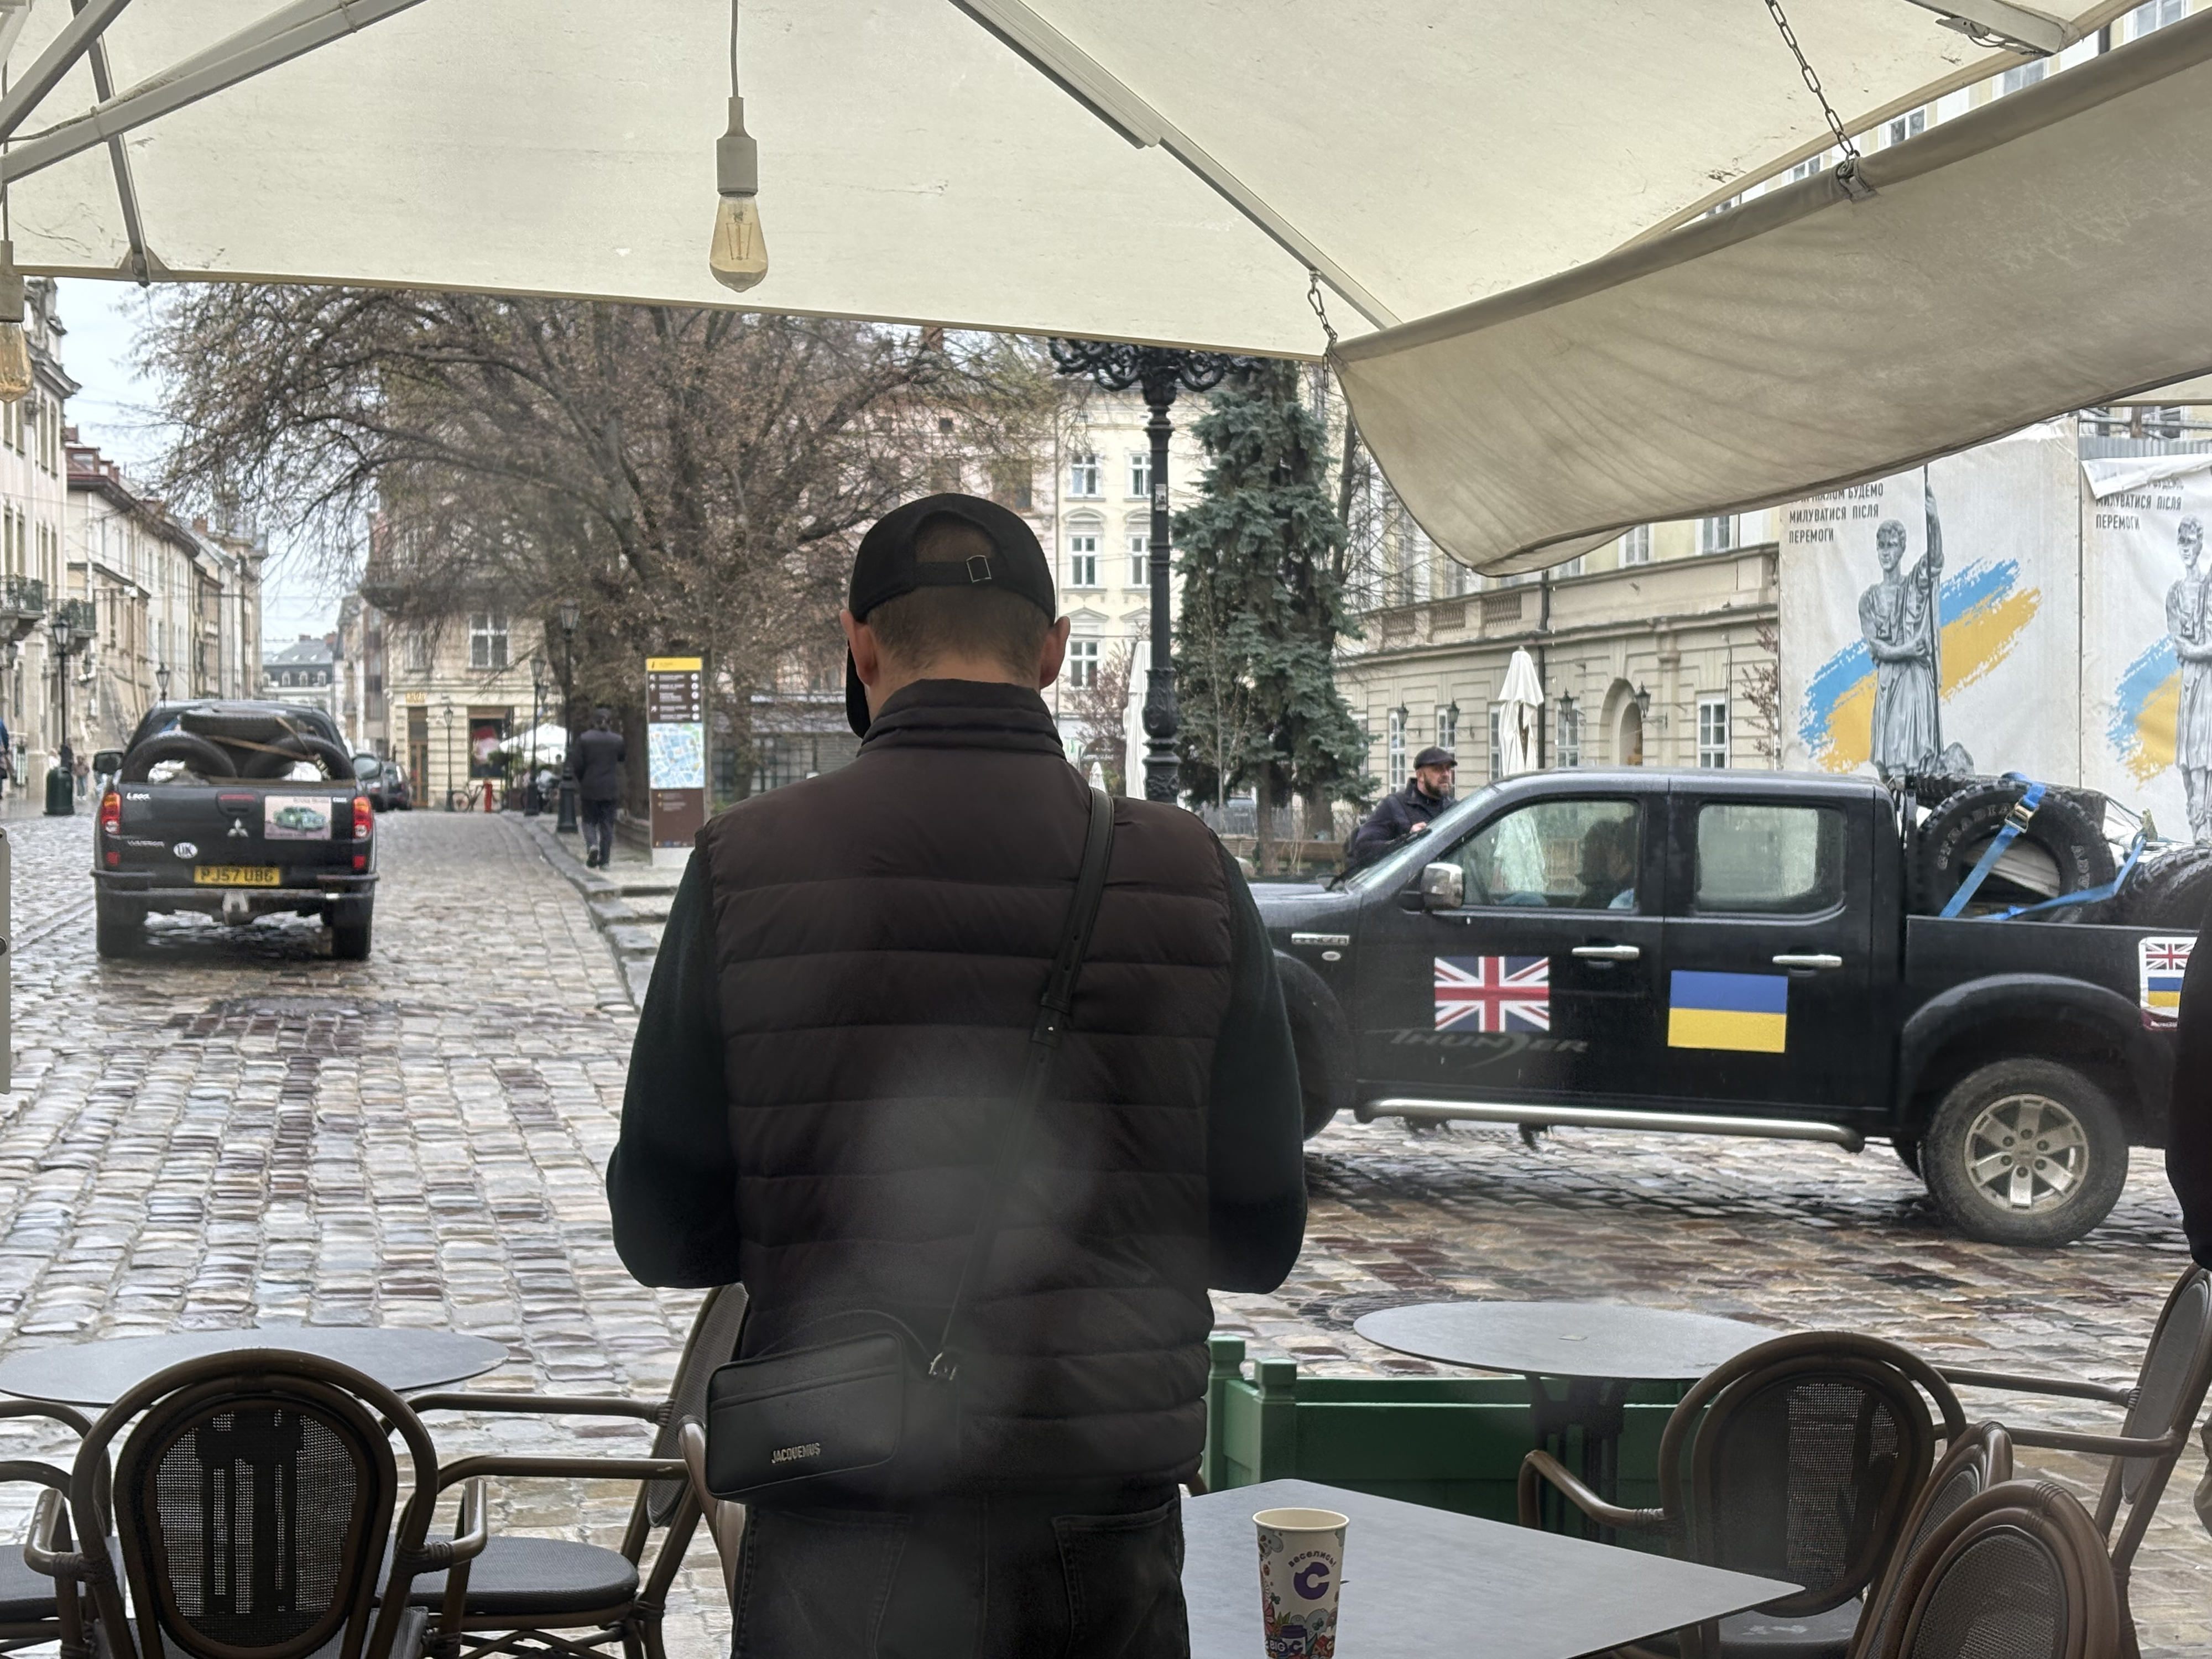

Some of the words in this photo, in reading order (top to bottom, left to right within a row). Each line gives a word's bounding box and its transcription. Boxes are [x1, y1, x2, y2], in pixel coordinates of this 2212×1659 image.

[1849, 483, 1884, 500] БУДЕМО
[2157, 495, 2182, 511] ПІСЛЯ
[1790, 506, 1846, 523] МИЛУВАТИСЯ
[1853, 504, 1879, 519] ПІСЛЯ
[2096, 514, 2140, 530] ПЕРЕМОГИ
[1789, 528, 1834, 544] ПЕРЕМОГИ
[176, 844, 194, 858] UK
[771, 1442, 821, 1464] JACQUEMUS
[1269, 1639, 1286, 1652] BIG
